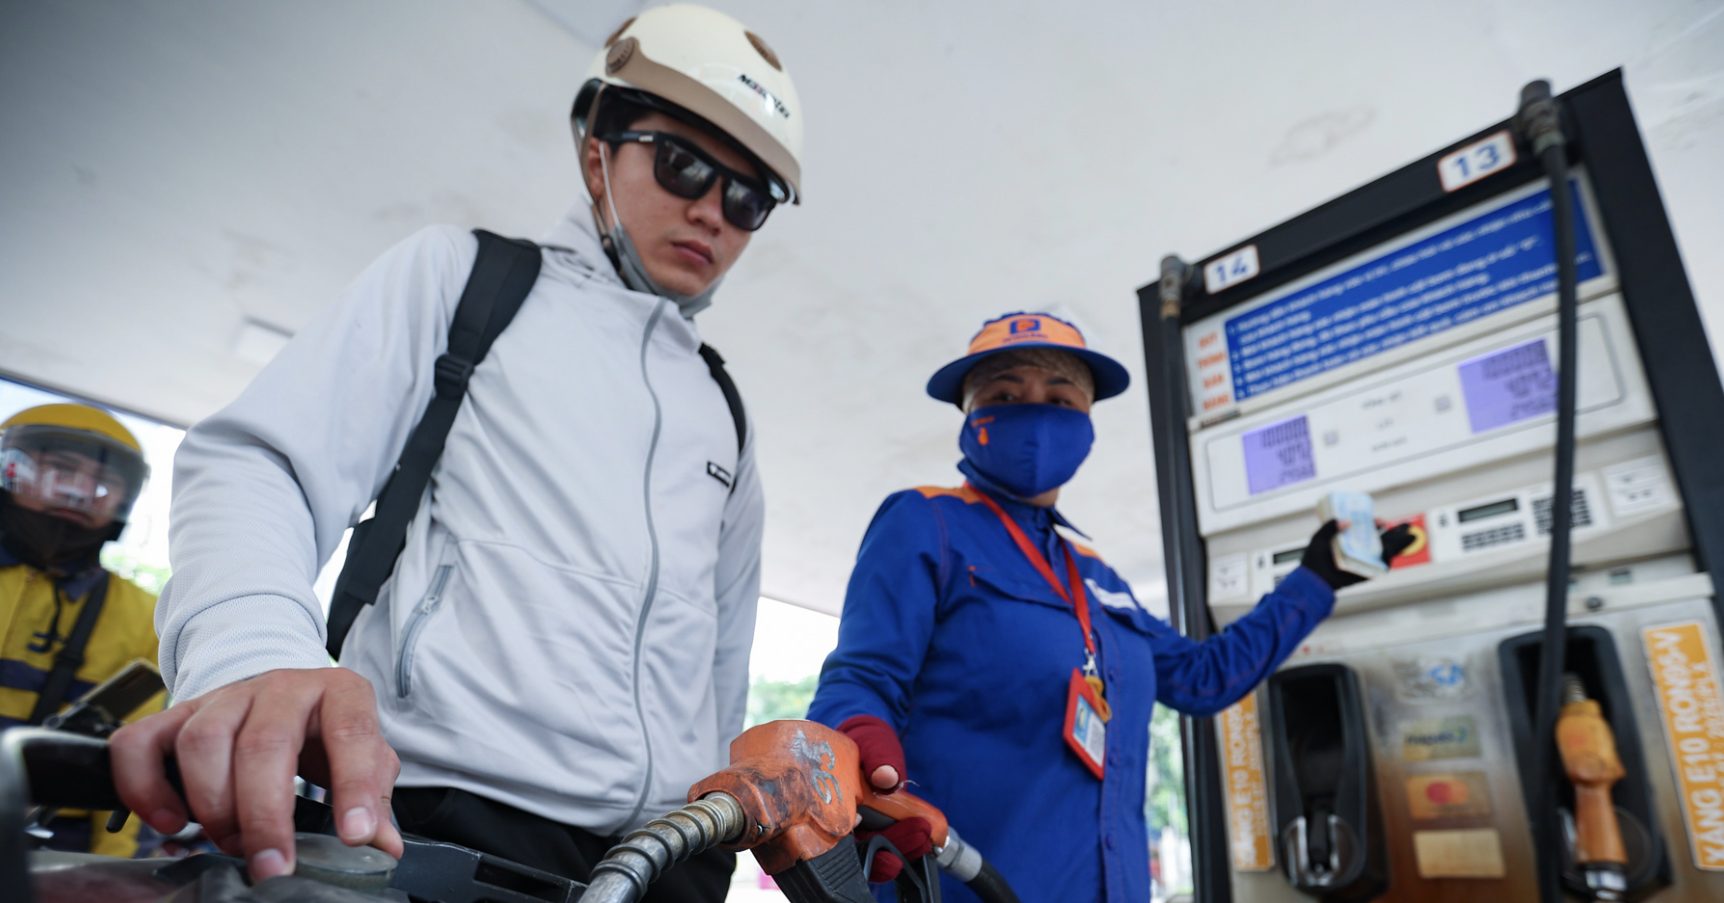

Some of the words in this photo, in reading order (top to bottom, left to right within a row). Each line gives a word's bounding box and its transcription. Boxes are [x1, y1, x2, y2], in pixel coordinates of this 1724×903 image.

[1453, 144, 1500, 178] 13
[1216, 257, 1247, 282] 14
[1679, 737, 1716, 783] E10
